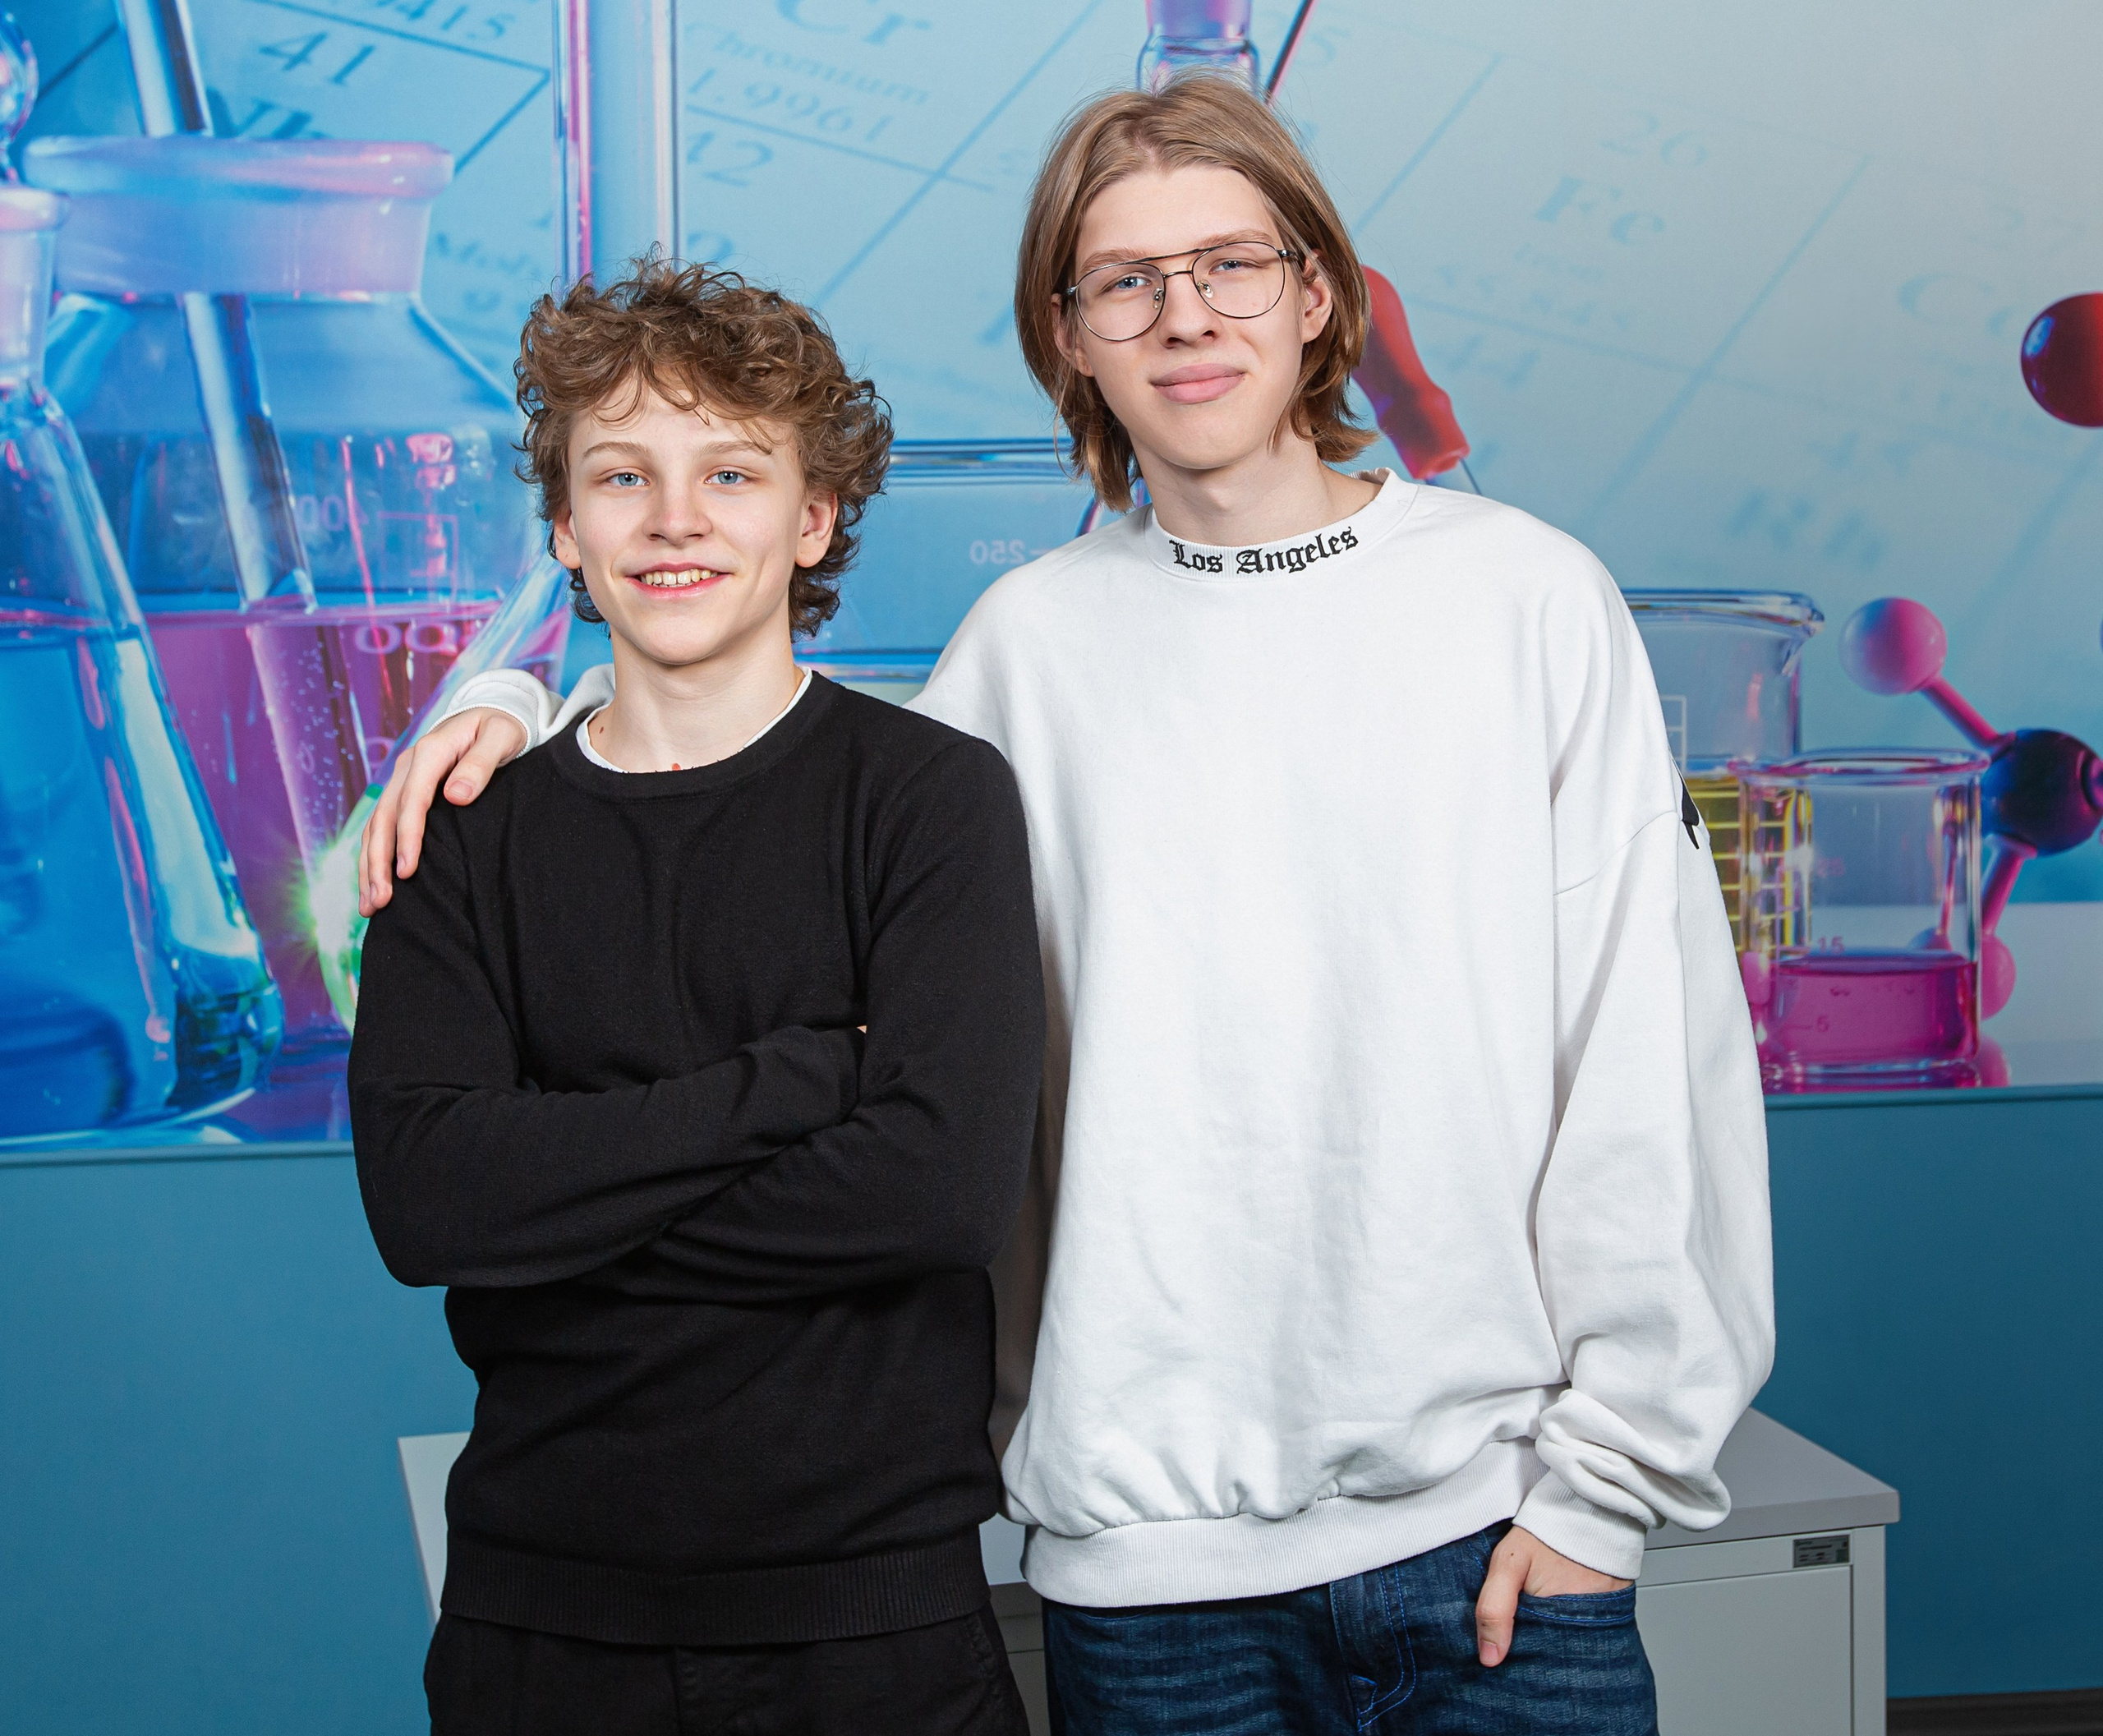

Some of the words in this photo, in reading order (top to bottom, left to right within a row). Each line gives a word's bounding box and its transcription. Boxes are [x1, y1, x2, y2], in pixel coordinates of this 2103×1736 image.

[257, 31, 376, 86] 41
[1534, 174, 1667, 247] Fe
[1169, 539, 1223, 573] Los
[1236, 526, 1359, 573] Angeles
